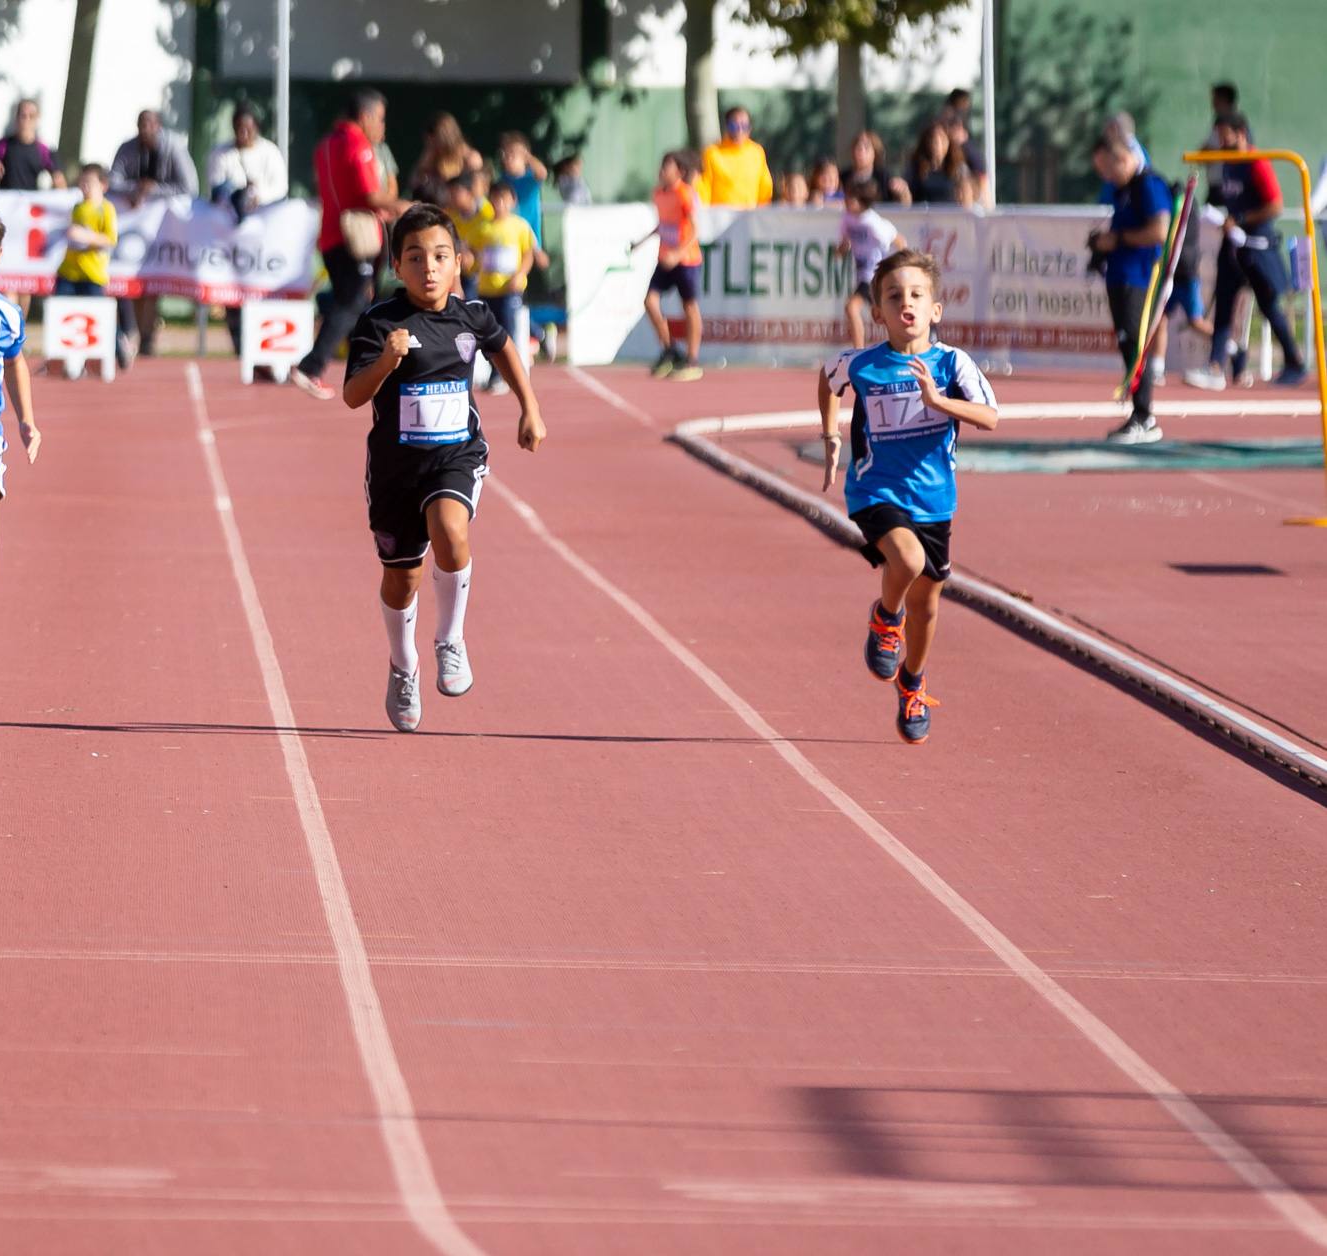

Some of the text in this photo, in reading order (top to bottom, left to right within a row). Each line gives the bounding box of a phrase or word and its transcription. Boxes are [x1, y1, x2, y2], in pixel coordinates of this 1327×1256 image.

[61, 312, 97, 348] 3
[259, 319, 296, 352] 2
[408, 398, 463, 428] 172
[873, 396, 935, 427] 171
